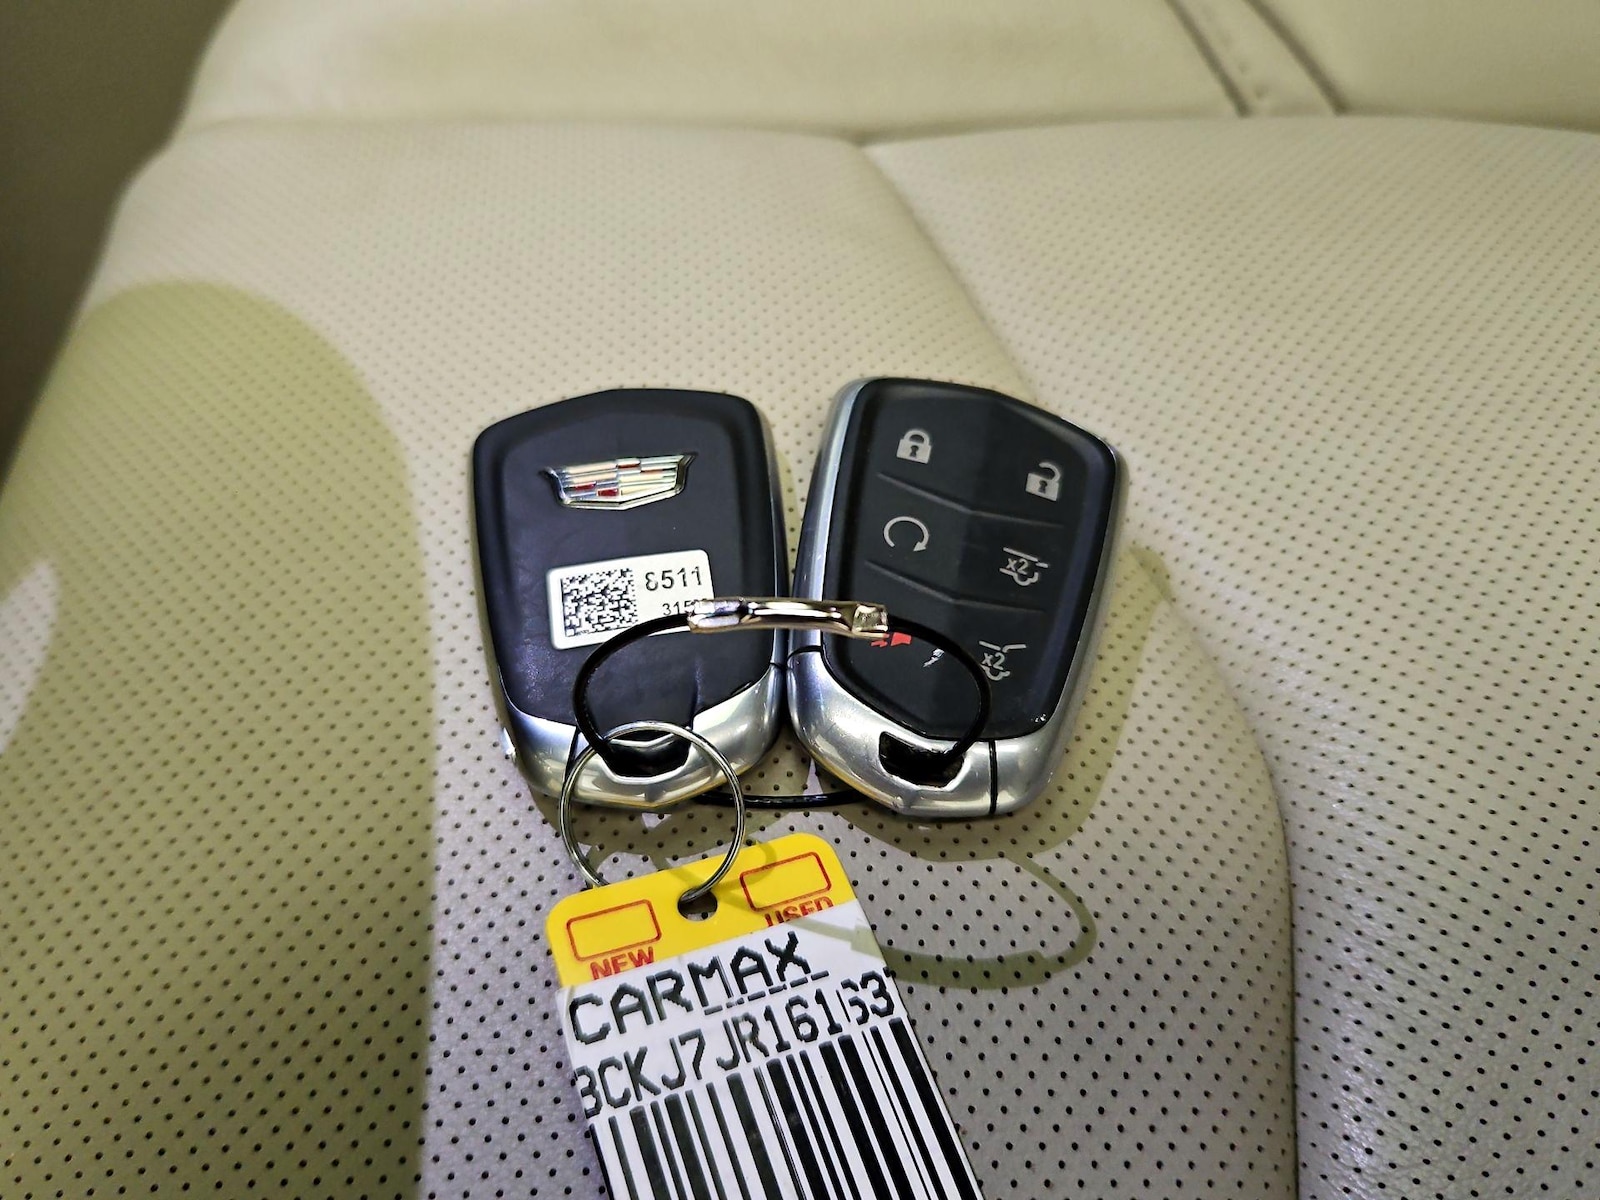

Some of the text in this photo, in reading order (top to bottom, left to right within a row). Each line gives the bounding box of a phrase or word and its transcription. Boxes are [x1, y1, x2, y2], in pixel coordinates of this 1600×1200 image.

[645, 566, 702, 591] 8511
[662, 598, 707, 616] 315
[590, 946, 655, 980] NEW
[569, 931, 811, 1045] CARMAX
[574, 966, 896, 1119] 3CKJ7JR16163
